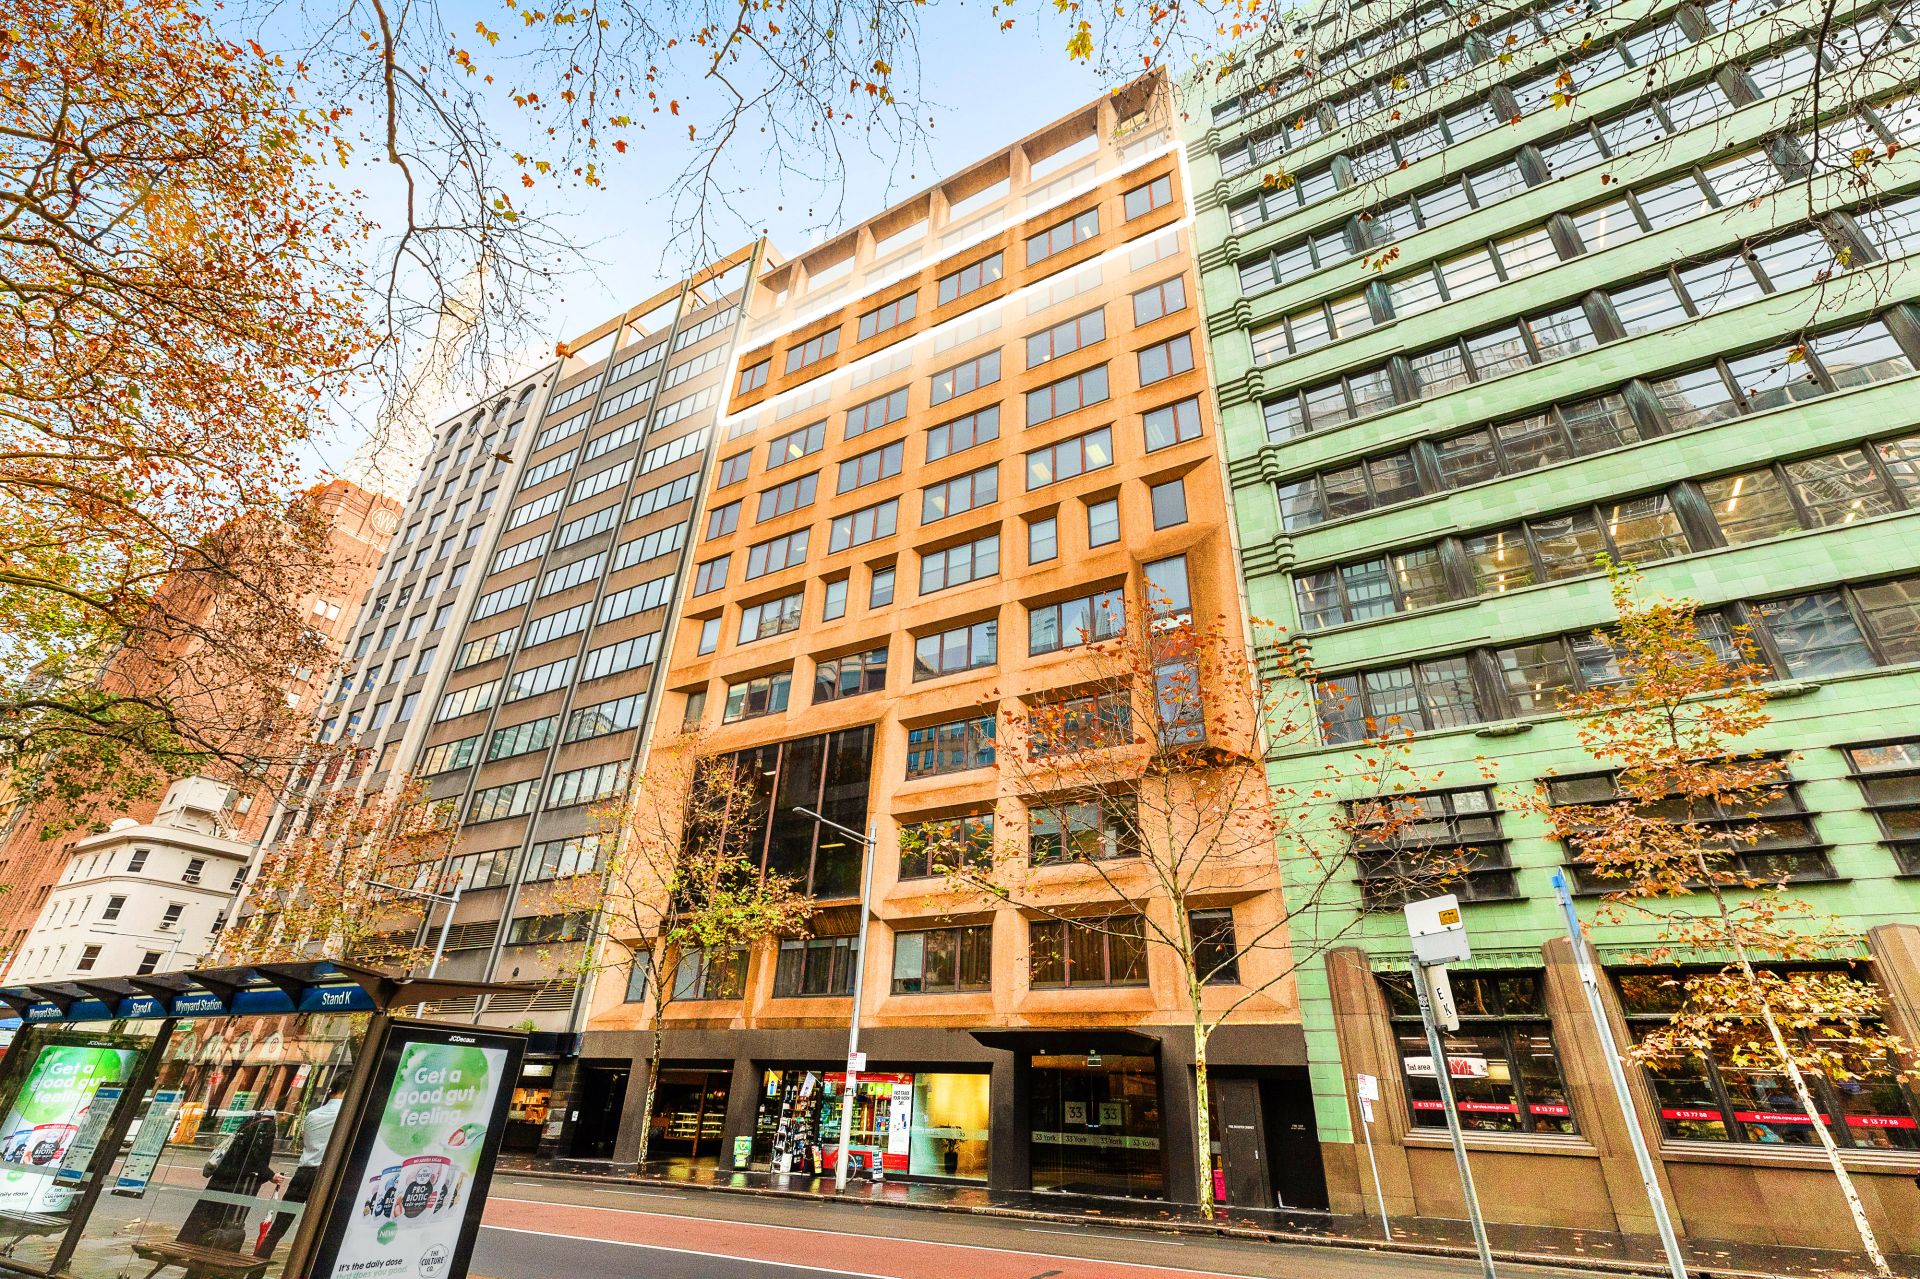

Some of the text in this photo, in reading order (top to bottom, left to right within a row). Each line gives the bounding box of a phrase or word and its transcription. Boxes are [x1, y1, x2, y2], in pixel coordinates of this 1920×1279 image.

[321, 990, 353, 1006] Stand K
[132, 1002, 147, 1013] Stand
[175, 998, 223, 1013] Wynyard Station
[448, 1035, 476, 1044] JCDecaux
[50, 1062, 95, 1075] Get a
[414, 1067, 462, 1084] Get a
[31, 1075, 107, 1092] good gut
[393, 1085, 476, 1109] good gut
[1069, 1106, 1083, 1119] 33
[1103, 1107, 1118, 1120] 33
[1141, 1139, 1155, 1147] York
[405, 1193, 428, 1202] BIOTIC
[338, 1258, 403, 1272] It's the daily dose
[421, 1257, 445, 1266] CULTURE
[352, 1271, 372, 1279] does
[373, 1269, 387, 1277] you
